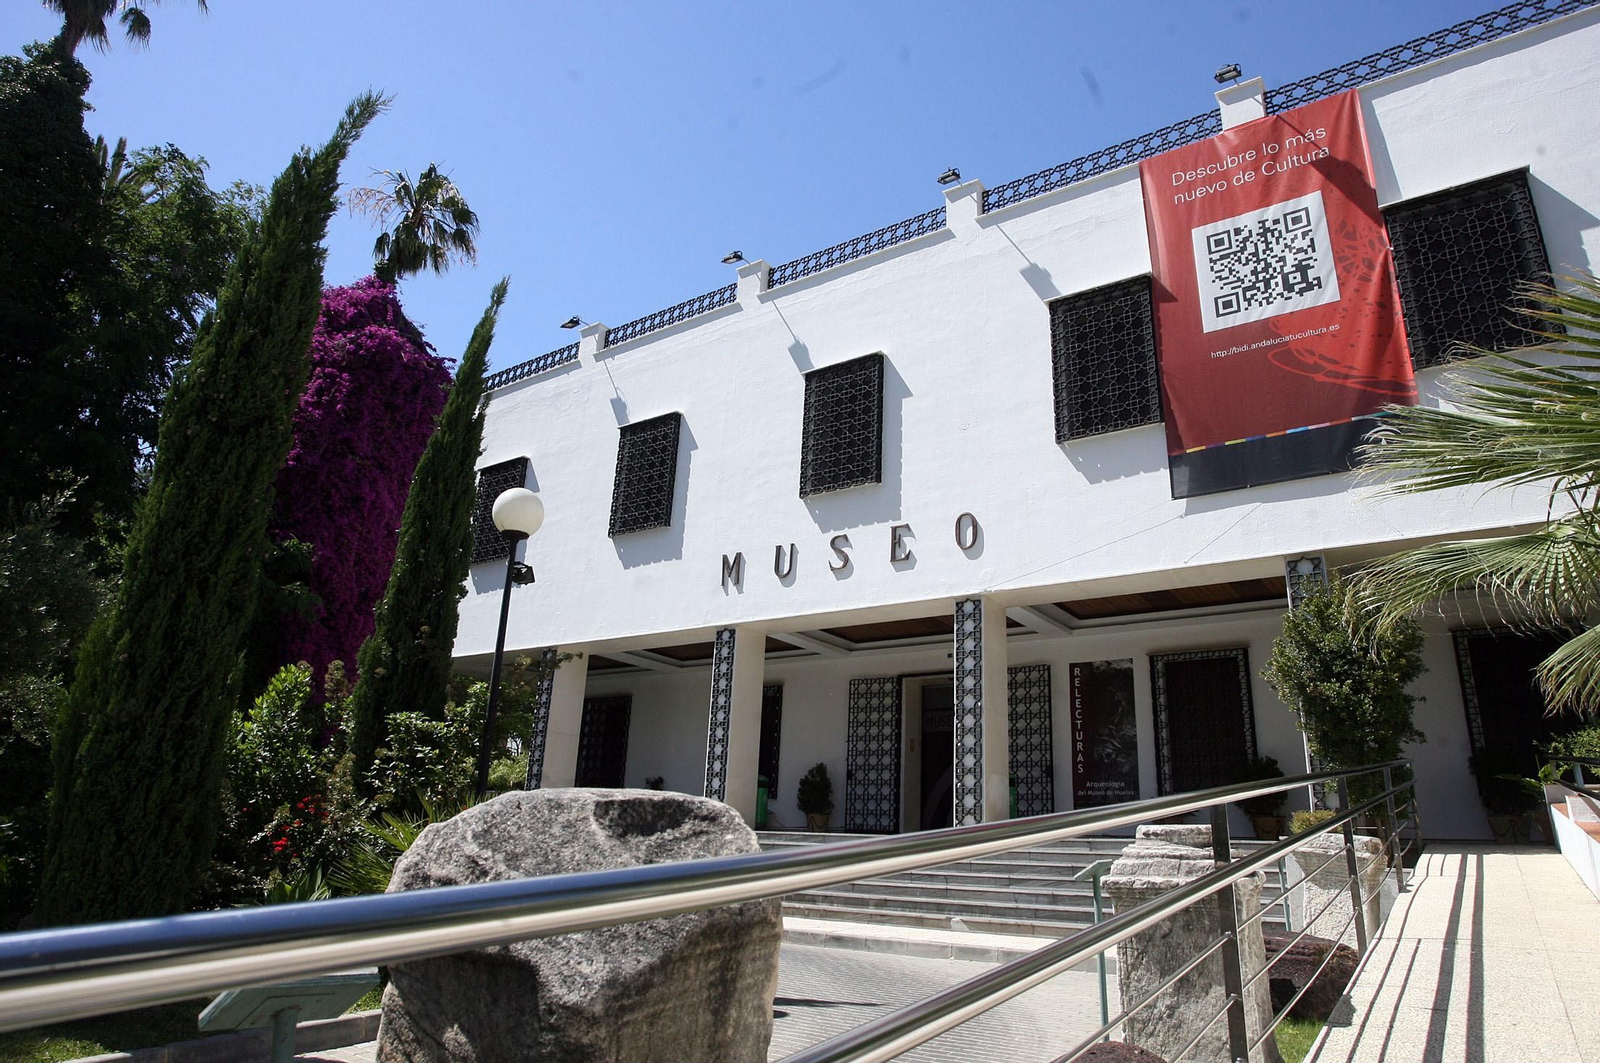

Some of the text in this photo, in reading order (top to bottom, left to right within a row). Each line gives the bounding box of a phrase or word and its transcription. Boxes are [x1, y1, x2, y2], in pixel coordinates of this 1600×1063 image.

[1172, 127, 1327, 186] Descubre lo más
[1174, 146, 1330, 205] nuevo de Cultura
[721, 512, 978, 586] MUSEO
[1074, 667, 1084, 773] RELECTURAS
